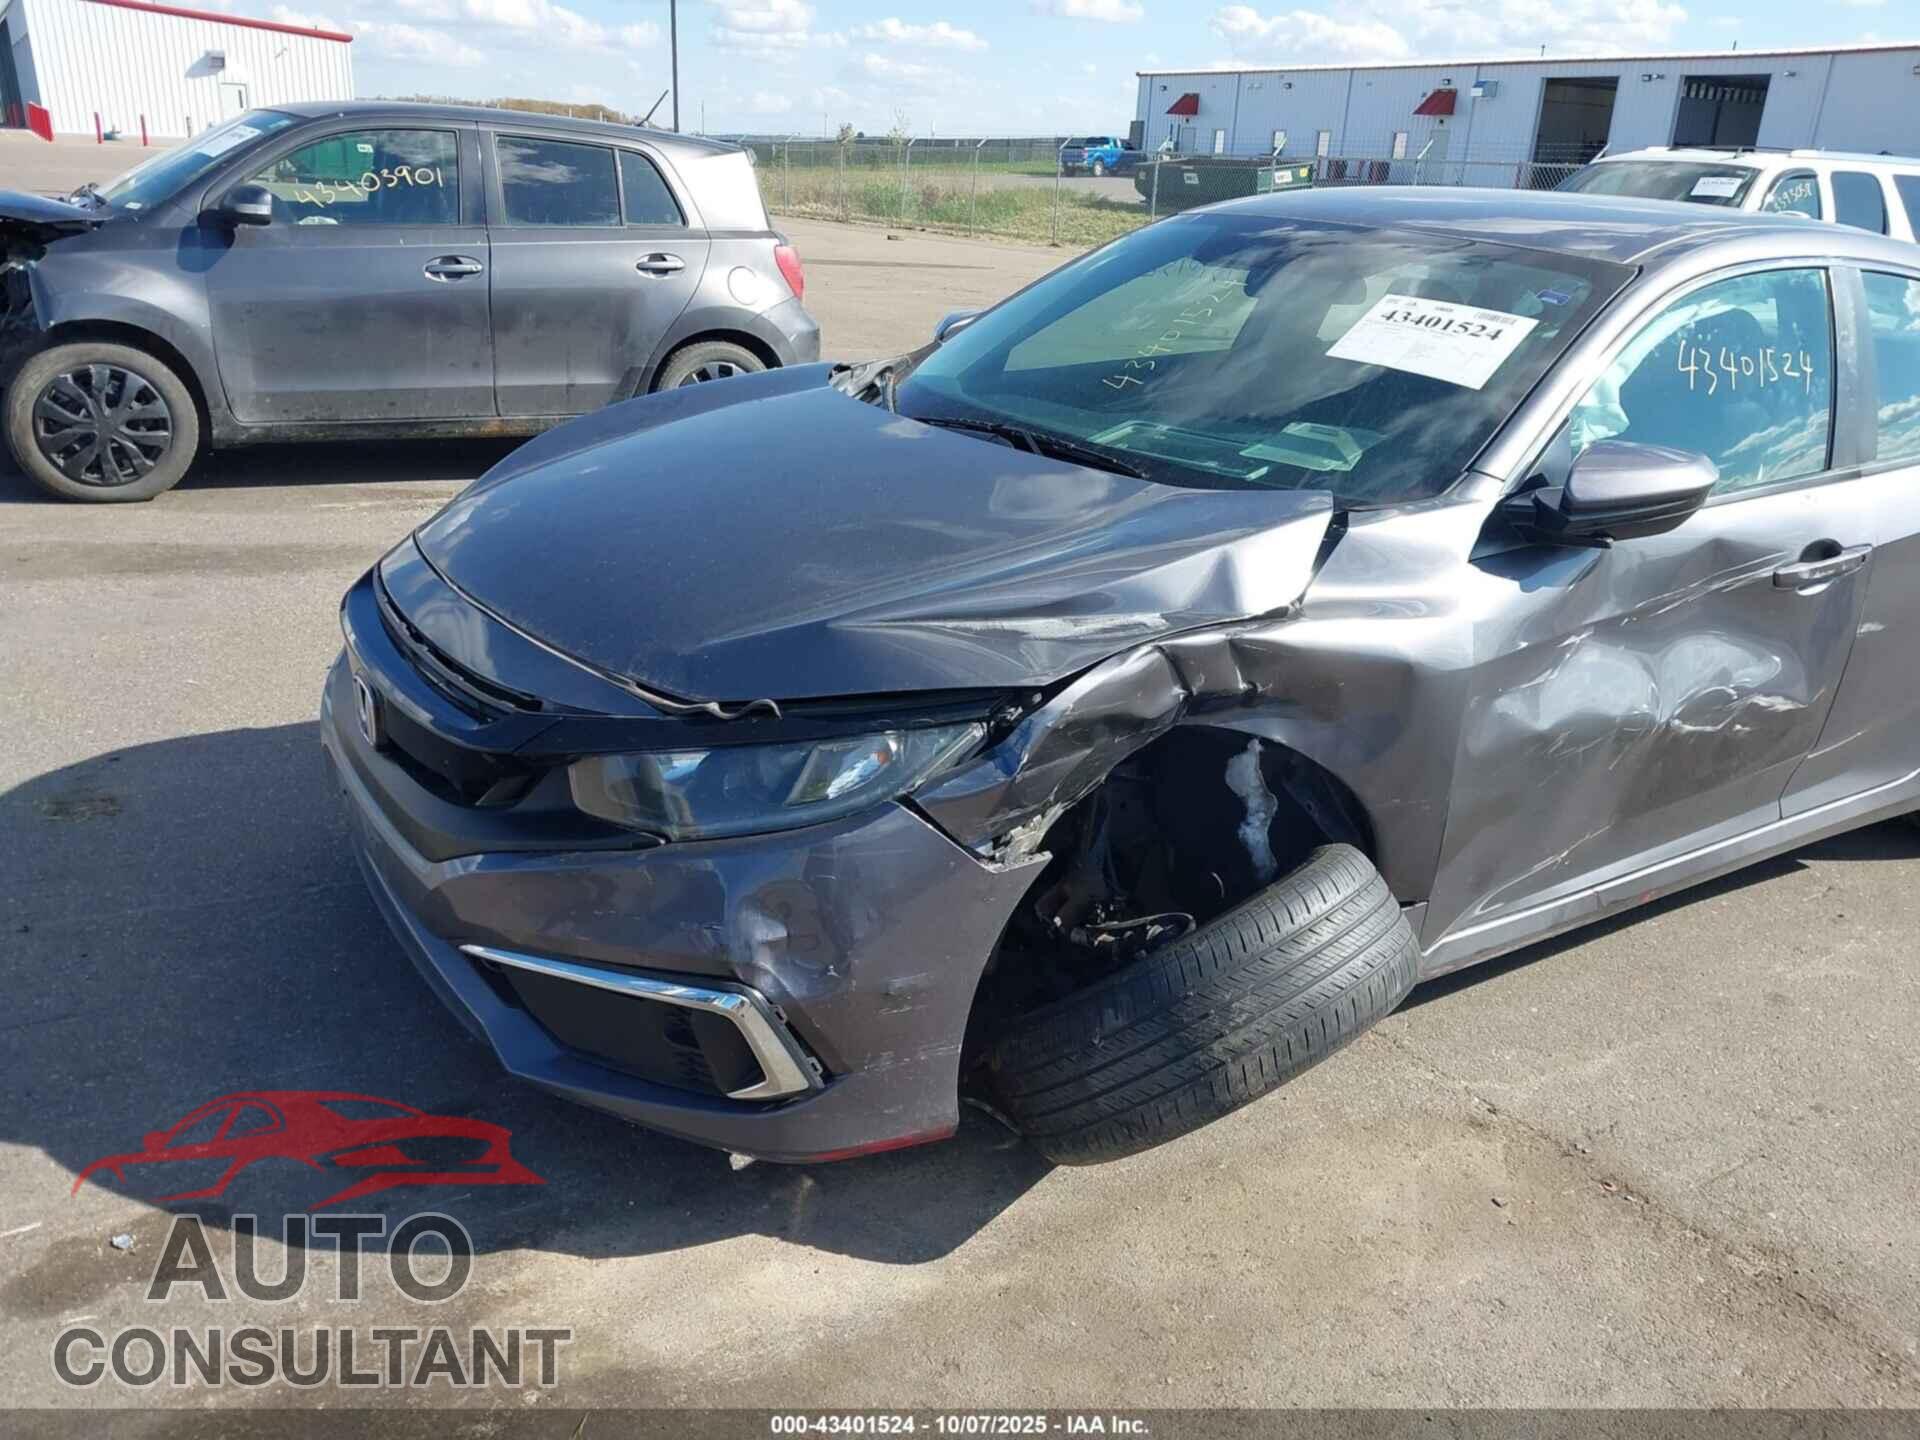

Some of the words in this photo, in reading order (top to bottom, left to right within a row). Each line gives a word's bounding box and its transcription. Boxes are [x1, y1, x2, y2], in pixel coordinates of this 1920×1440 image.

[294, 165, 443, 208] 43403901
[1381, 309, 1504, 341] 43401524
[1678, 339, 1813, 395] 43401524
